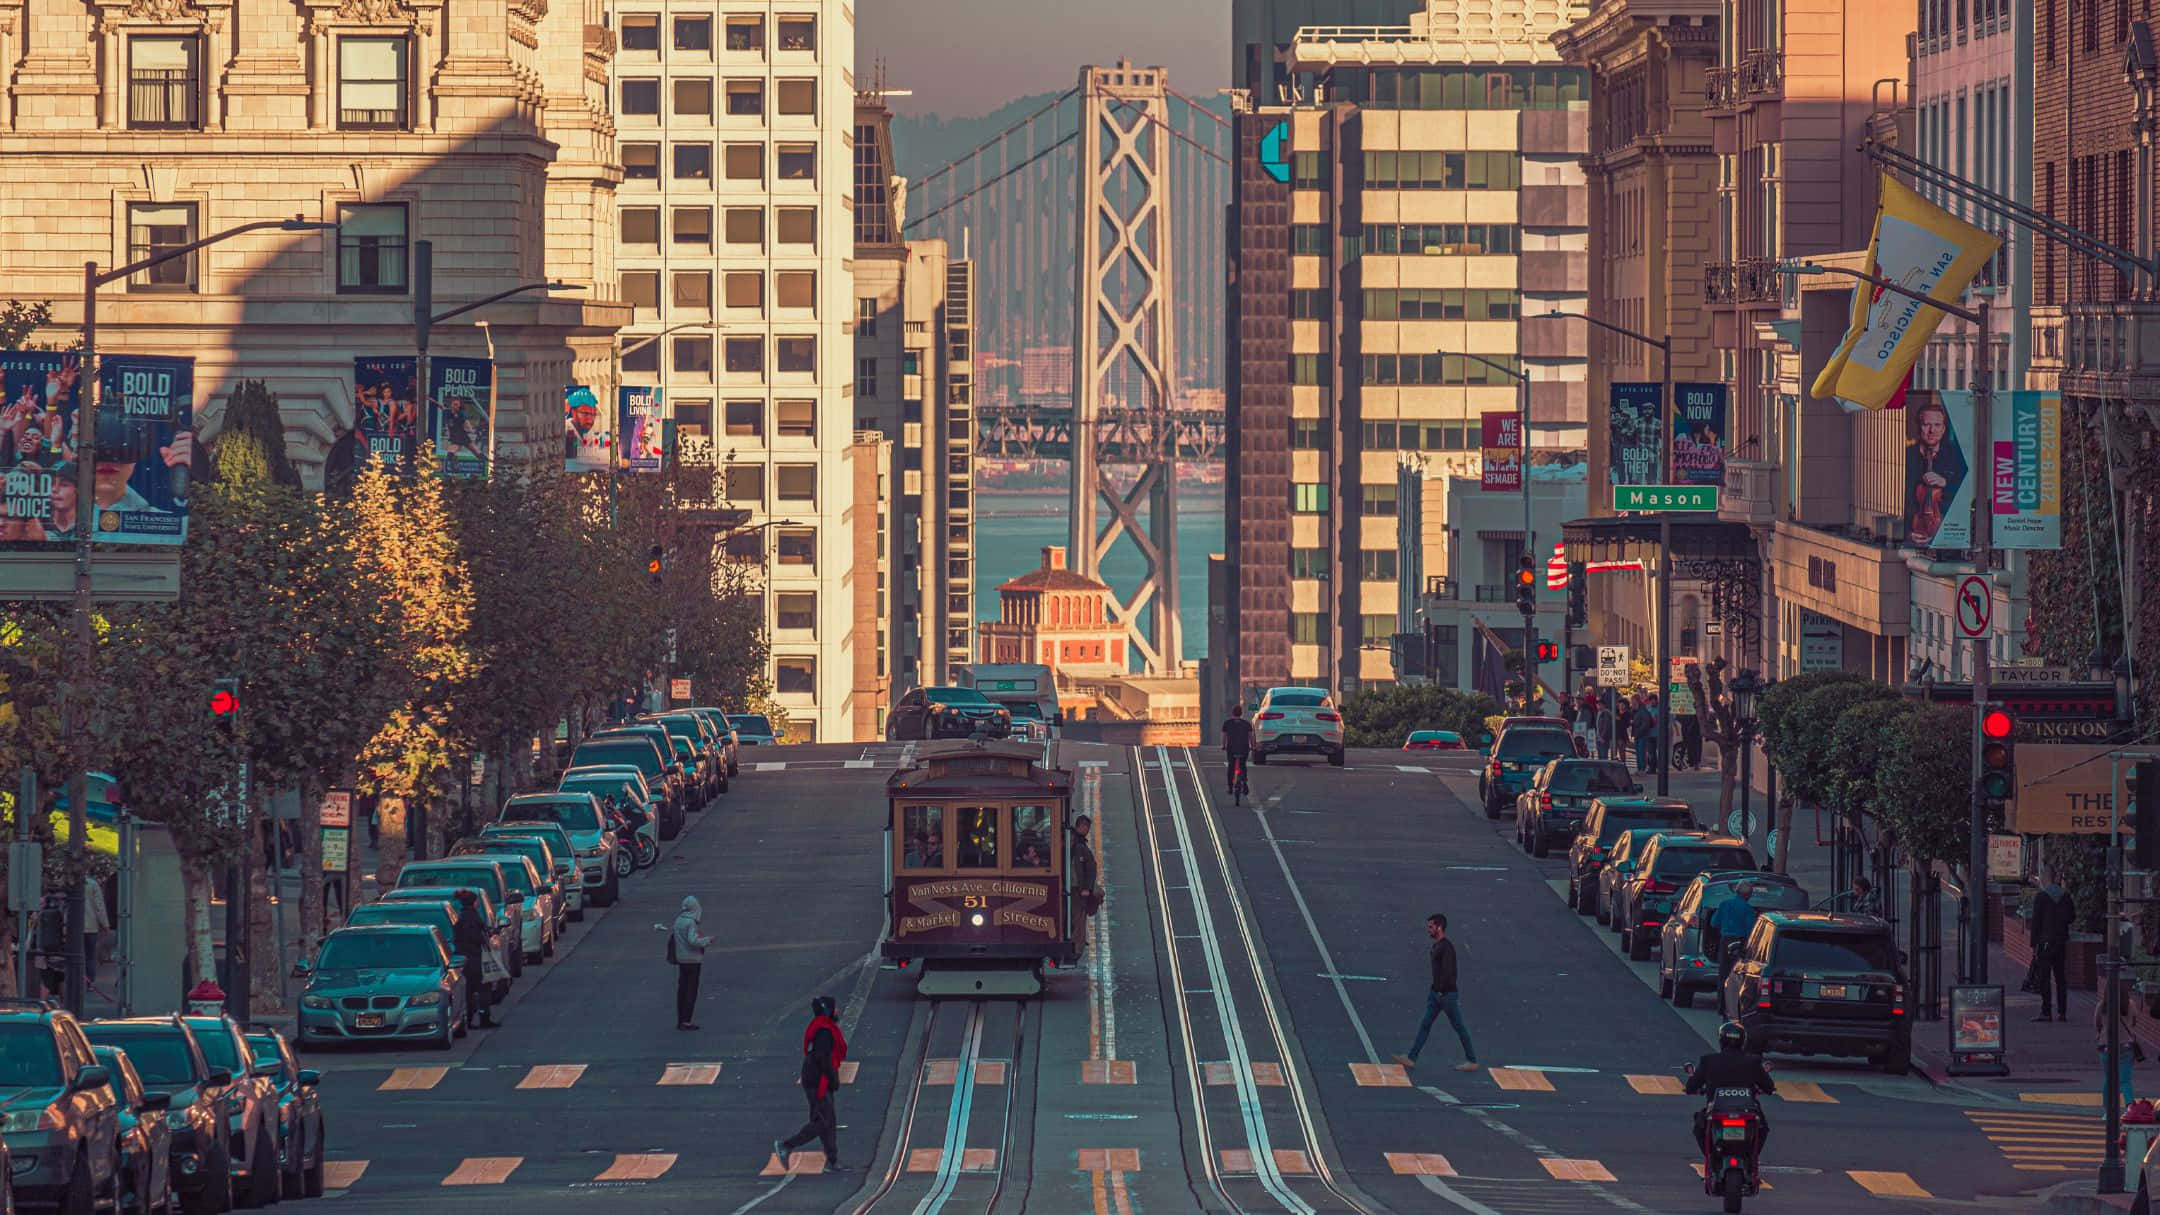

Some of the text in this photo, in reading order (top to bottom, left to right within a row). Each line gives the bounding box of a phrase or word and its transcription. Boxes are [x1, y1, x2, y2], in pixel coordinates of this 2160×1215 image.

[445, 368, 477, 384] BOLD
[123, 371, 171, 396] BOLD
[444, 384, 474, 397] PLAYS
[123, 396, 169, 415] VISION
[629, 394, 651, 406] BOLD
[1687, 392, 1713, 406] BOLD
[1687, 406, 1712, 420] NOW
[1501, 418, 1518, 432] WE
[371, 438, 401, 453] BOLD
[1497, 433, 1517, 446] ARE
[1623, 448, 1649, 461] BOLD
[2017, 410, 2037, 504] CENTURY
[1624, 461, 1649, 474] THEN
[5, 473, 52, 496] BOLD
[1485, 473, 1518, 485] SFMADE
[1996, 457, 2014, 503] NEW
[1630, 491, 1701, 504] Mason
[6, 497, 51, 517] VOICE
[1600, 669, 1610, 677] DO
[2001, 671, 2060, 681] TAYLOR
[2065, 793, 2114, 810] THE
[992, 882, 1048, 897] California
[963, 895, 988, 908] 51
[906, 911, 956, 928] & Market
[1003, 911, 1048, 928] Streets
